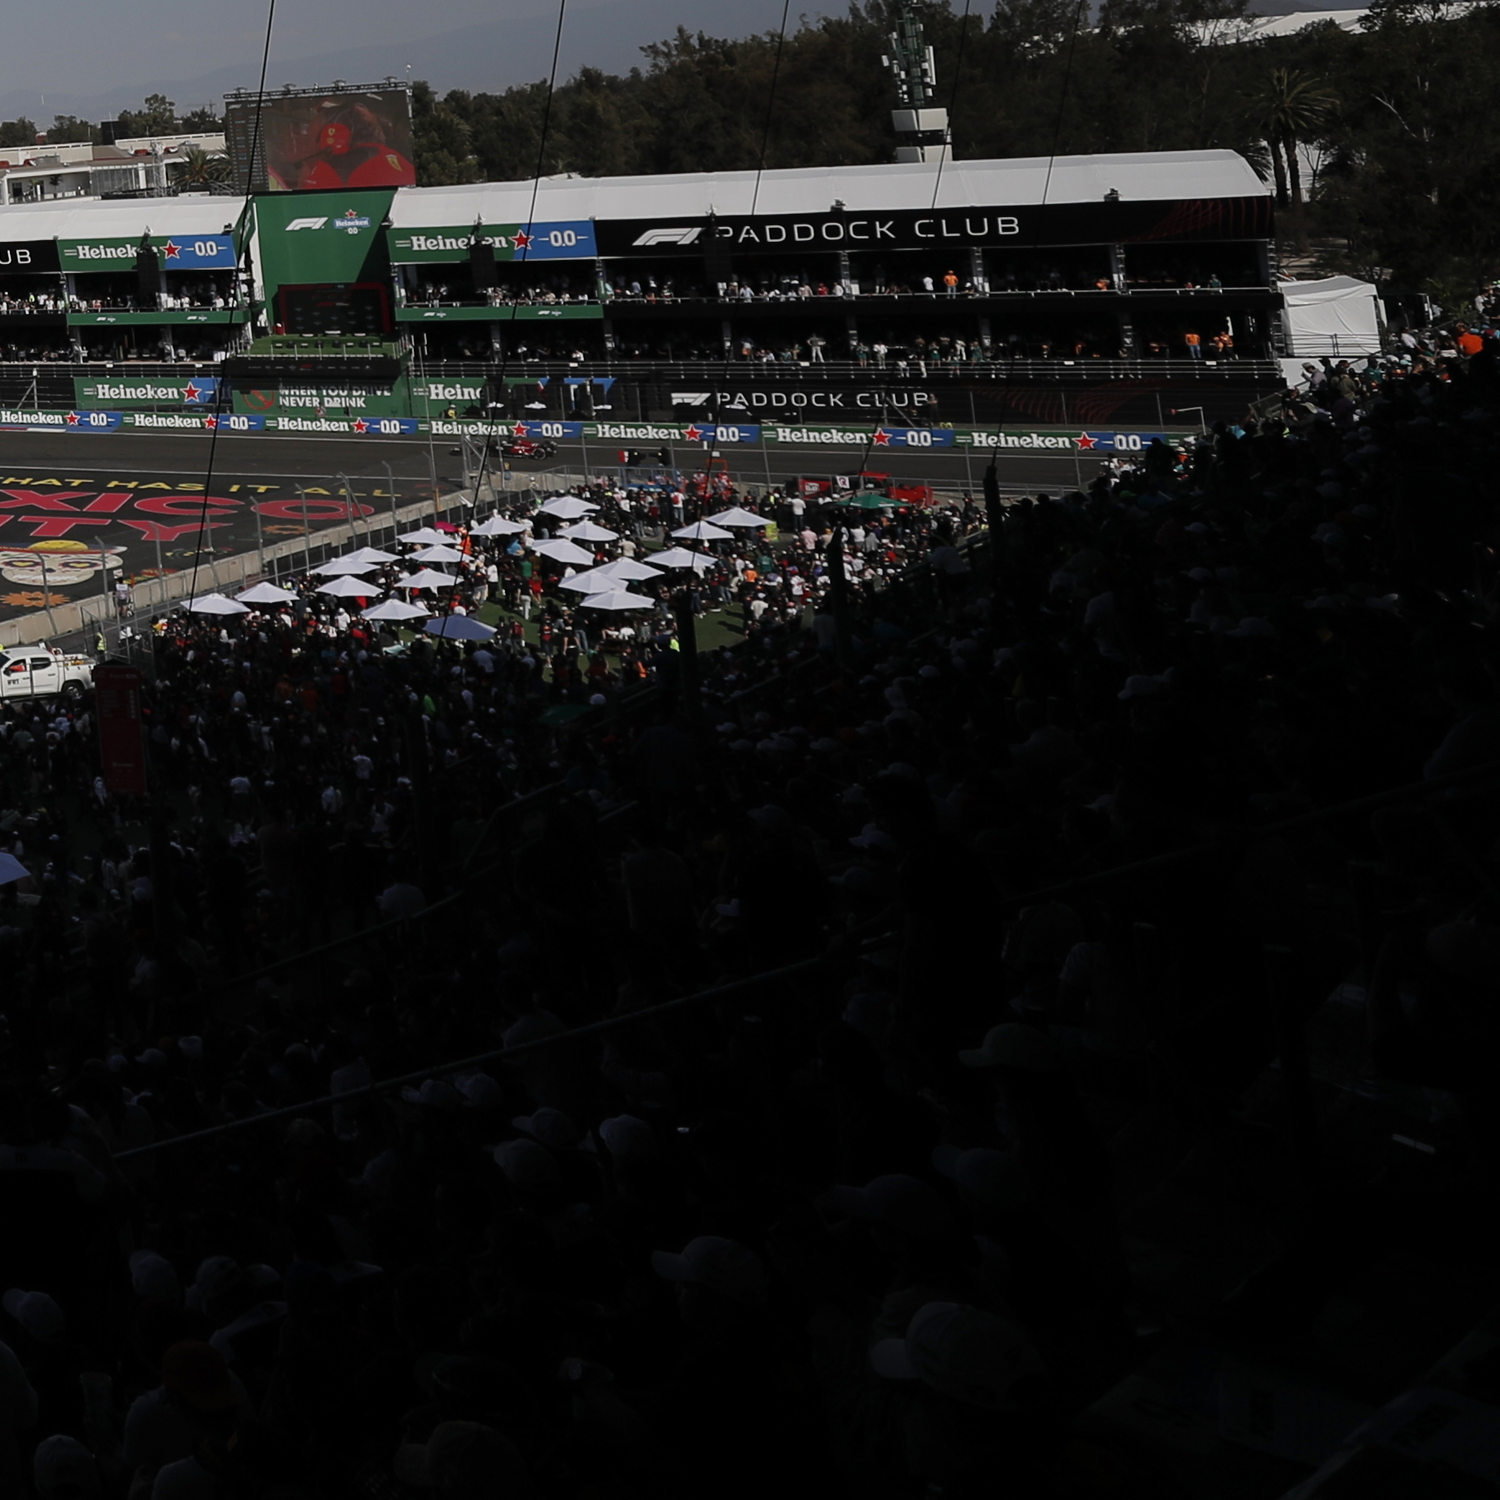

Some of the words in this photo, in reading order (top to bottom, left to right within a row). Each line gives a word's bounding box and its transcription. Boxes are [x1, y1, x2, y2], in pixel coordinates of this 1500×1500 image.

[334, 217, 370, 227] Heineken
[716, 219, 896, 244] PADDOCK
[914, 216, 1021, 237] CLUB
[76, 244, 159, 259] Heinek
[96, 384, 179, 400] Heineken
[279, 385, 317, 396] WHEN
[320, 385, 347, 396] YOU
[352, 385, 391, 396] DRIVE
[279, 396, 320, 408] NEVER
[324, 396, 367, 408] DRINK
[717, 392, 845, 408] PADDOCK
[855, 391, 929, 407] CLUB
[1, 411, 63, 425] Heineken
[134, 413, 200, 429] Heineken
[277, 416, 351, 433] Heineken
[430, 420, 508, 437] Heineken
[596, 424, 682, 441] Heineken
[777, 427, 874, 446] Heineken
[972, 432, 1081, 449] Heineken
[106, 480, 206, 491] HAS
[229, 484, 281, 493] IT
[295, 487, 402, 498] ALL
